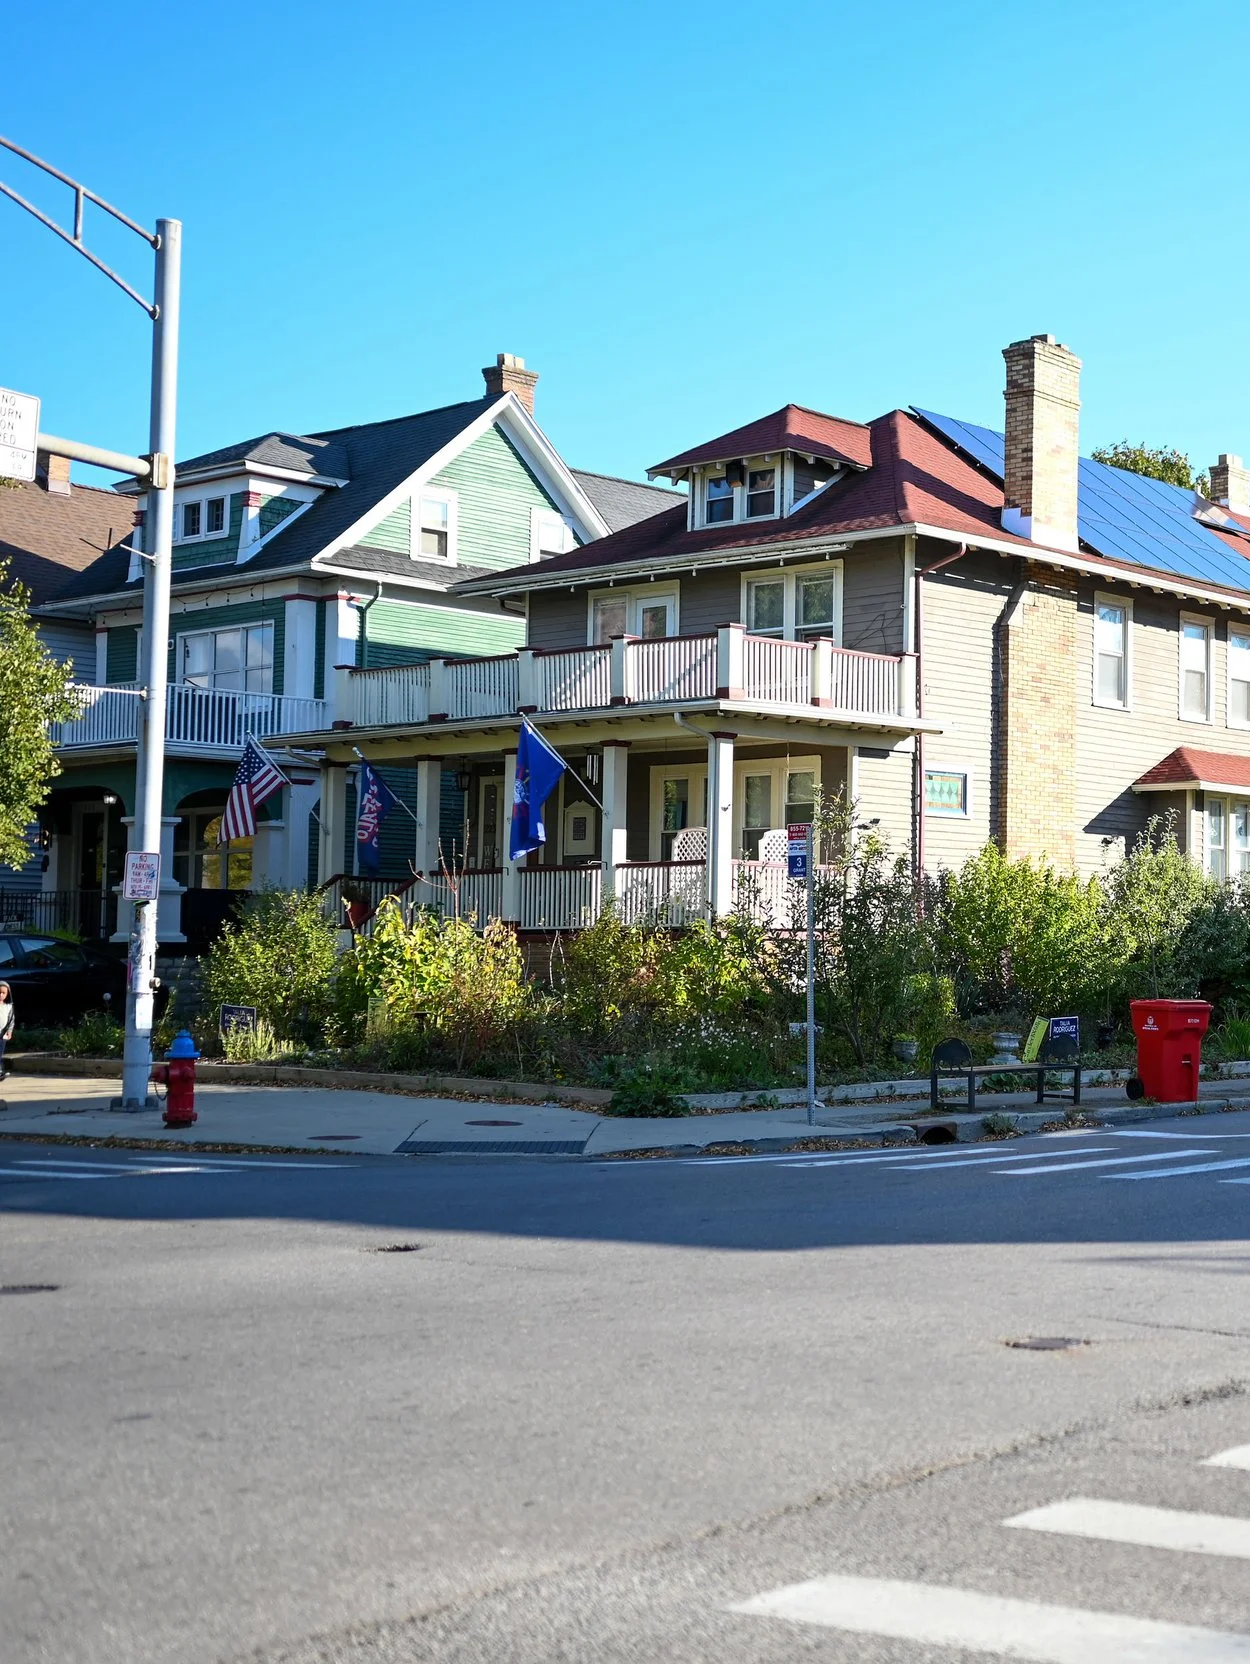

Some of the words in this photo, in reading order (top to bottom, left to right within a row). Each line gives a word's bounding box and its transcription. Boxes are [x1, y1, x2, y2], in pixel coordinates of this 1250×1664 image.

[2, 394, 16, 407] NO
[0, 406, 22, 420] URN
[0, 432, 16, 446] ED
[796, 857, 802, 867] 3
